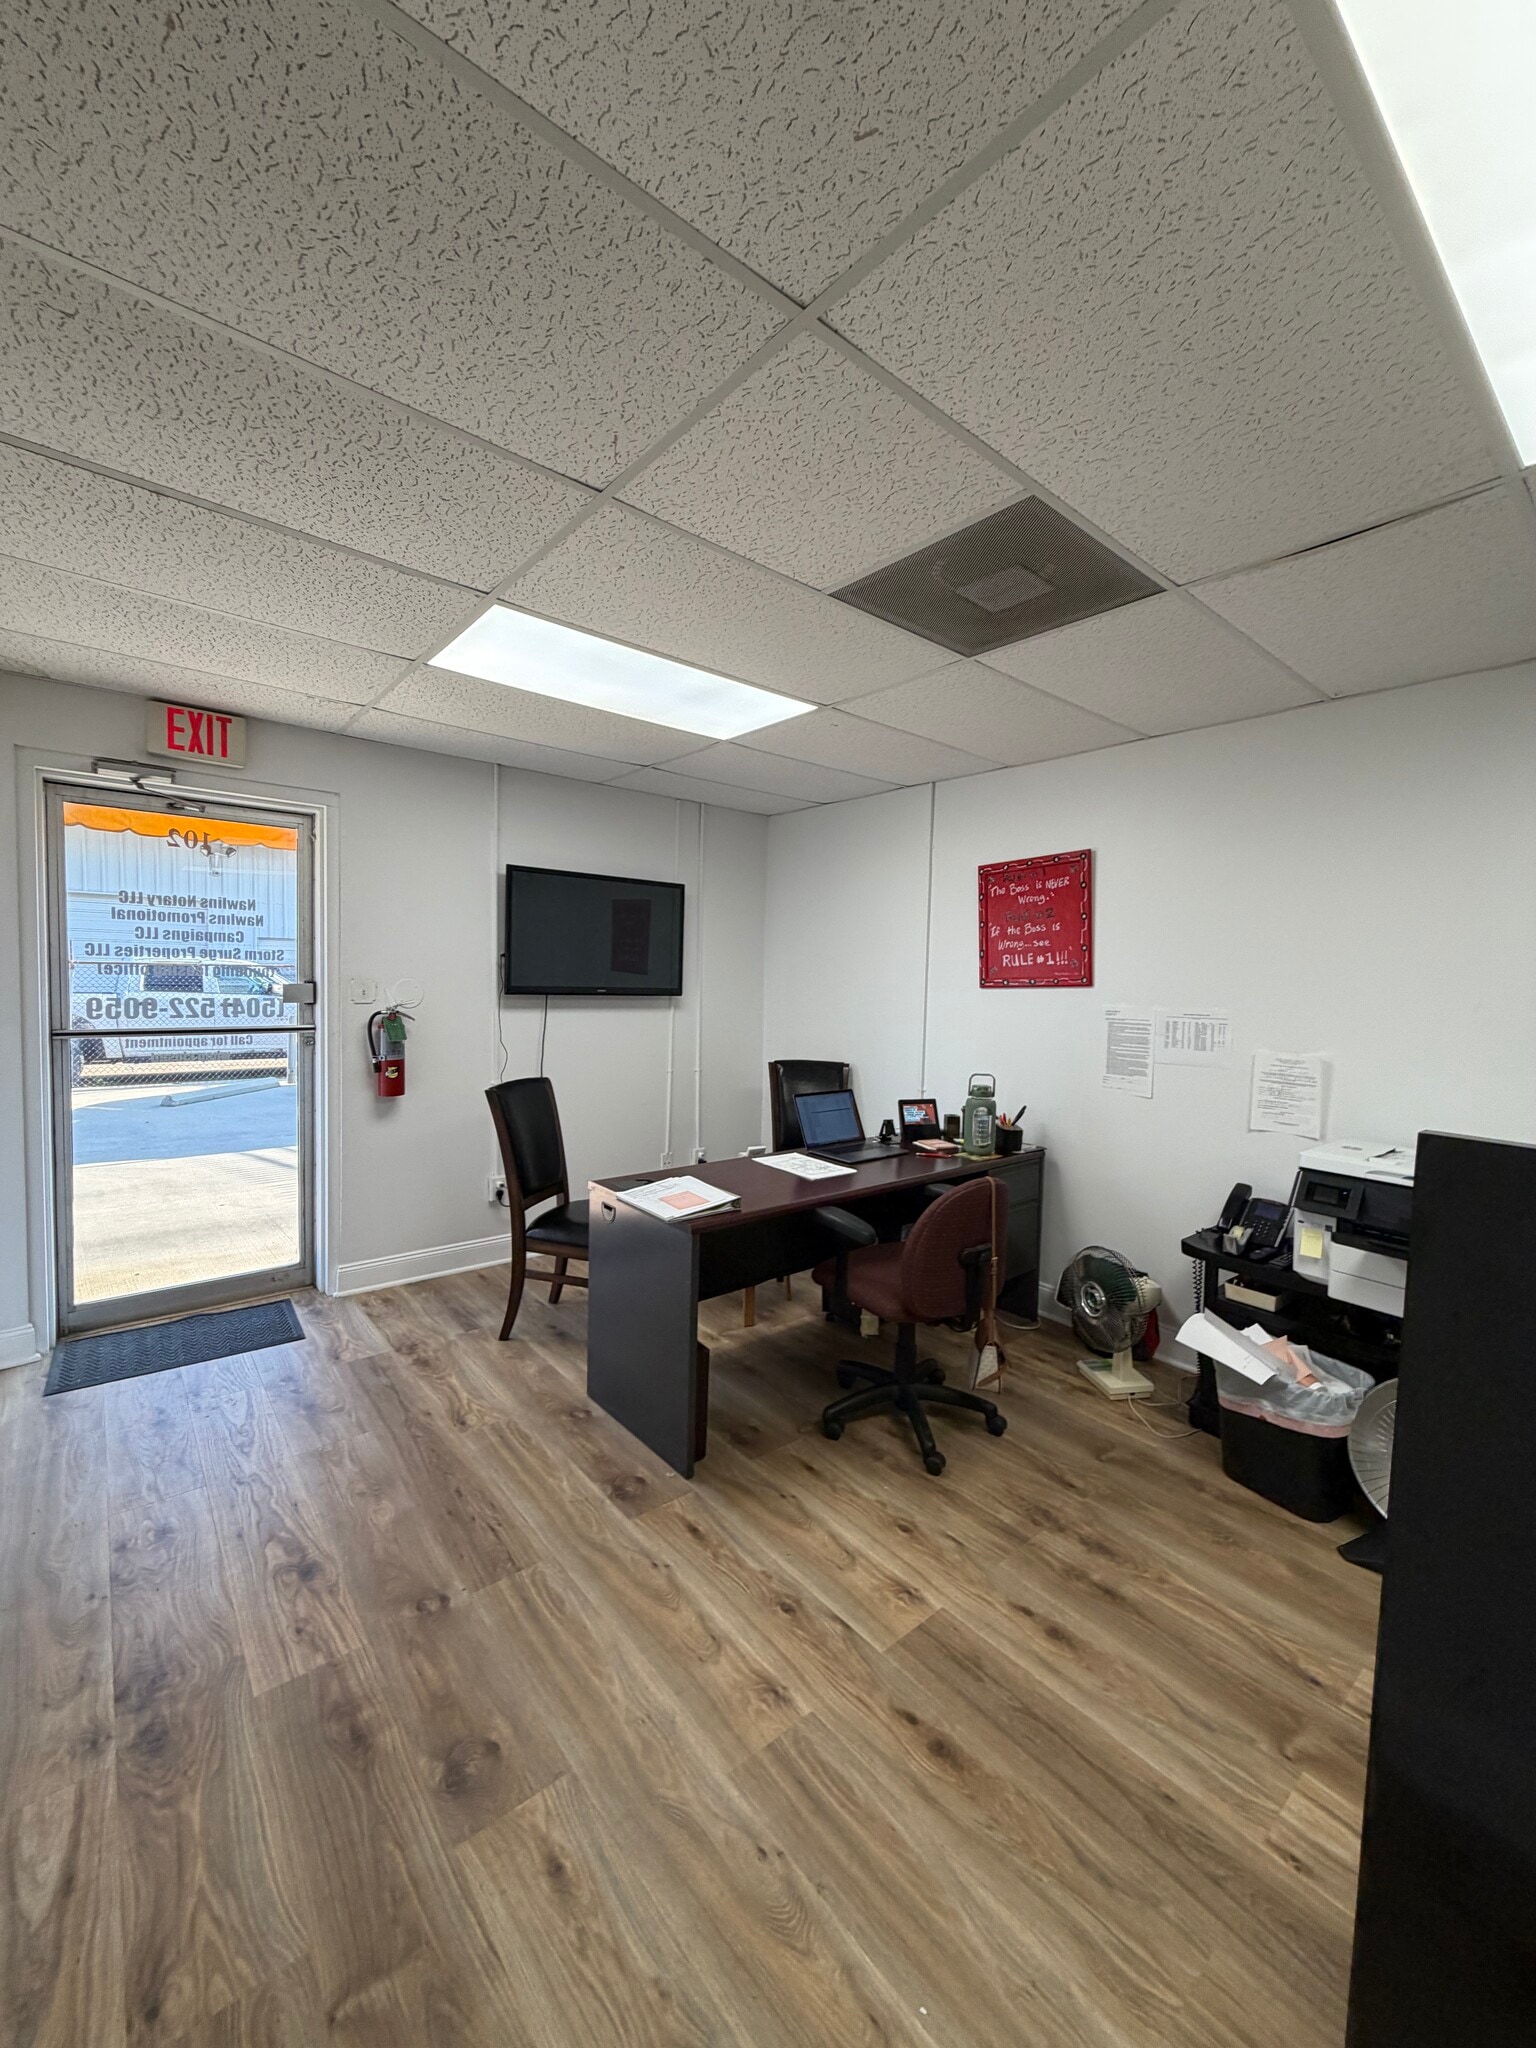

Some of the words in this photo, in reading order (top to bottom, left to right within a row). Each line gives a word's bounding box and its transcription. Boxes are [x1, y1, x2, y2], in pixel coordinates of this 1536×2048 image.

[166, 706, 233, 758] EXIT
[1009, 883, 1030, 896] Boss
[1035, 880, 1043, 889] is
[1045, 876, 1070, 889] NEVER
[1007, 925, 1021, 936] the
[1023, 922, 1047, 936] Boss
[1002, 952, 1034, 967] RULE
